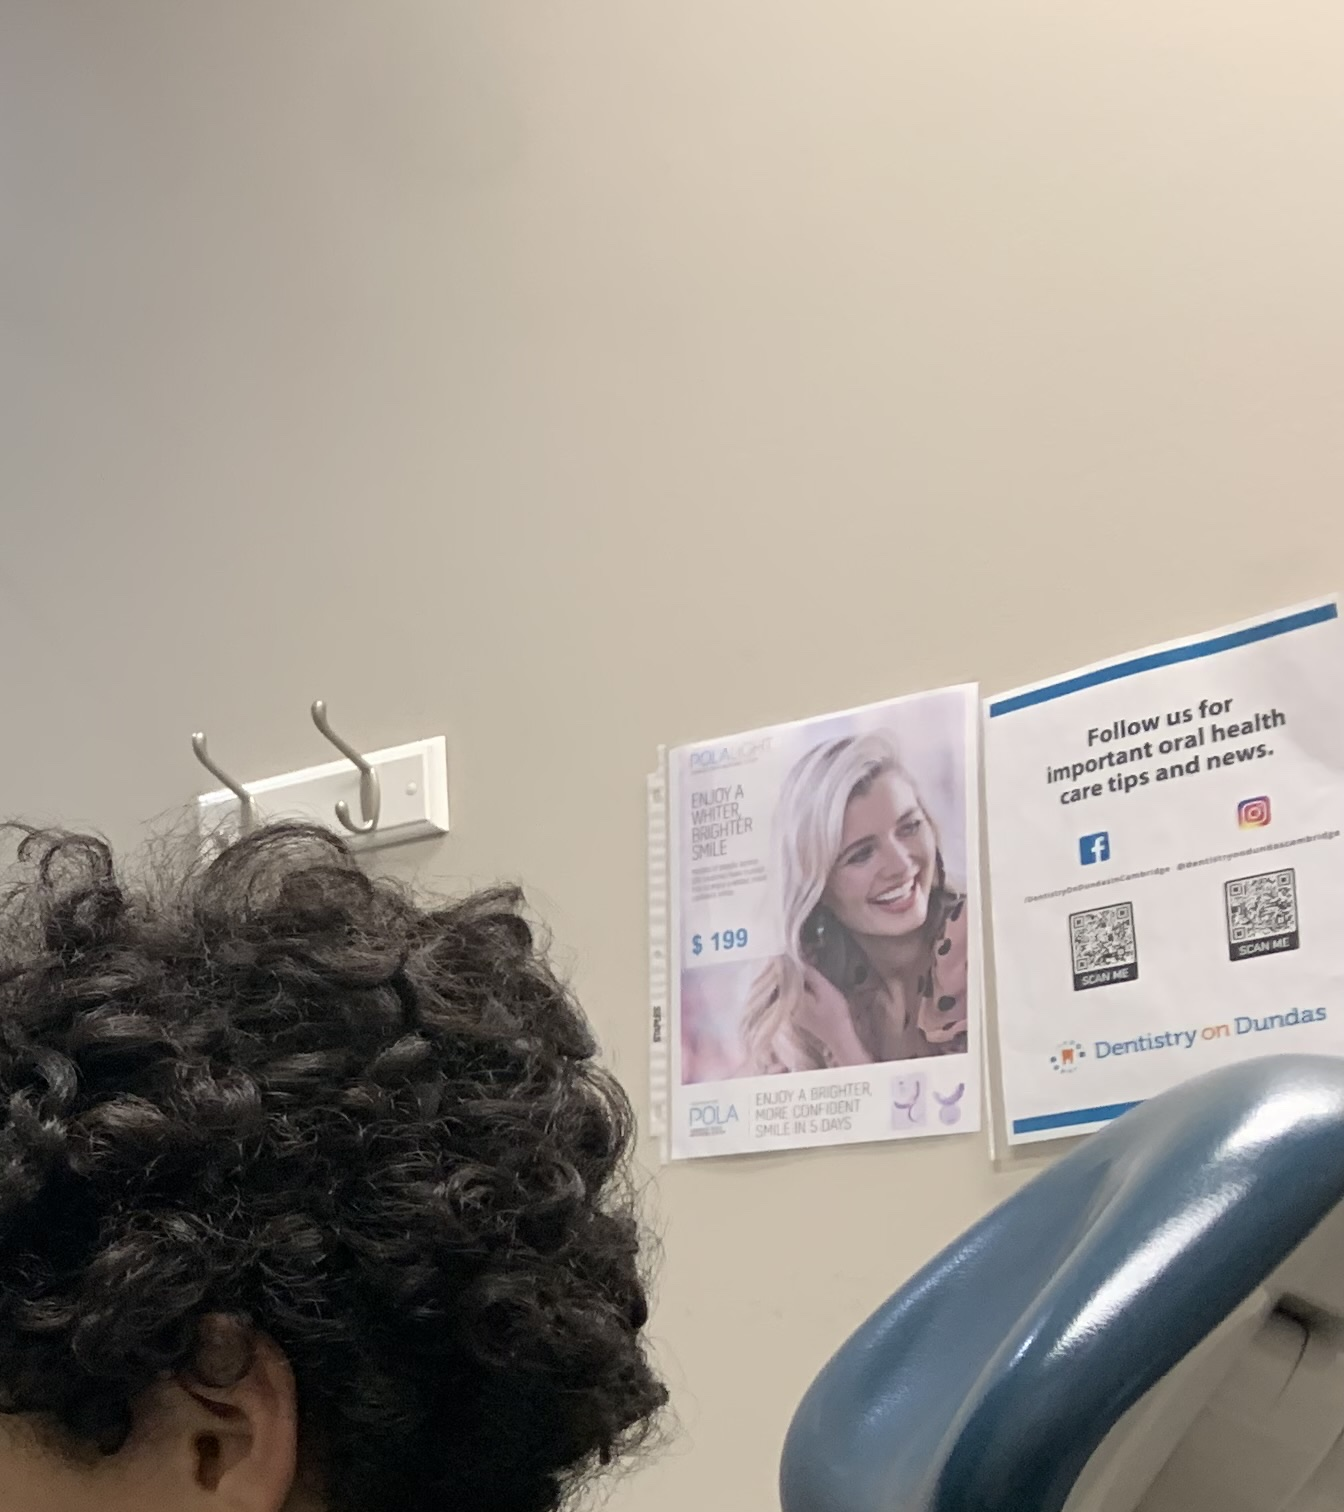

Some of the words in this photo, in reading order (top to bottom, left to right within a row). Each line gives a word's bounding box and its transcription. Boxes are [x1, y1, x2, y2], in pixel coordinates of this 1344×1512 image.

[1087, 715, 1160, 747] Follow
[1167, 708, 1193, 726] us
[1198, 698, 1233, 719] for
[1047, 741, 1153, 784] important
[1159, 727, 1205, 754] oral
[1211, 708, 1286, 743] health
[1060, 782, 1102, 805] care
[1108, 770, 1150, 793] tips
[1156, 755, 1200, 782] and
[1207, 742, 1274, 770] news.
[691, 785, 732, 809] ENJOY
[735, 784, 744, 800] A
[691, 817, 753, 844] BRIGHTER
[692, 839, 727, 861] SMILE
[691, 934, 703, 956] $
[710, 927, 748, 952] 199
[1238, 941, 1269, 956] SCAN
[1272, 937, 1290, 949] ME
[1081, 972, 1110, 986] SCAN
[1113, 967, 1129, 980] ME
[1095, 1028, 1197, 1059] Dentistry
[1201, 1023, 1230, 1041] on
[1235, 1006, 1327, 1035] Dundas
[756, 1090, 794, 1106] ENJOY
[798, 1088, 807, 1101] A
[689, 1104, 739, 1127] POLA
[756, 1104, 788, 1121] MORE
[793, 1098, 862, 1118] CONFIDENT
[756, 1121, 791, 1138] SMILE
[794, 1120, 806, 1134] IN
[811, 1119, 818, 1133] 5
[822, 1117, 852, 1132] DAYS
